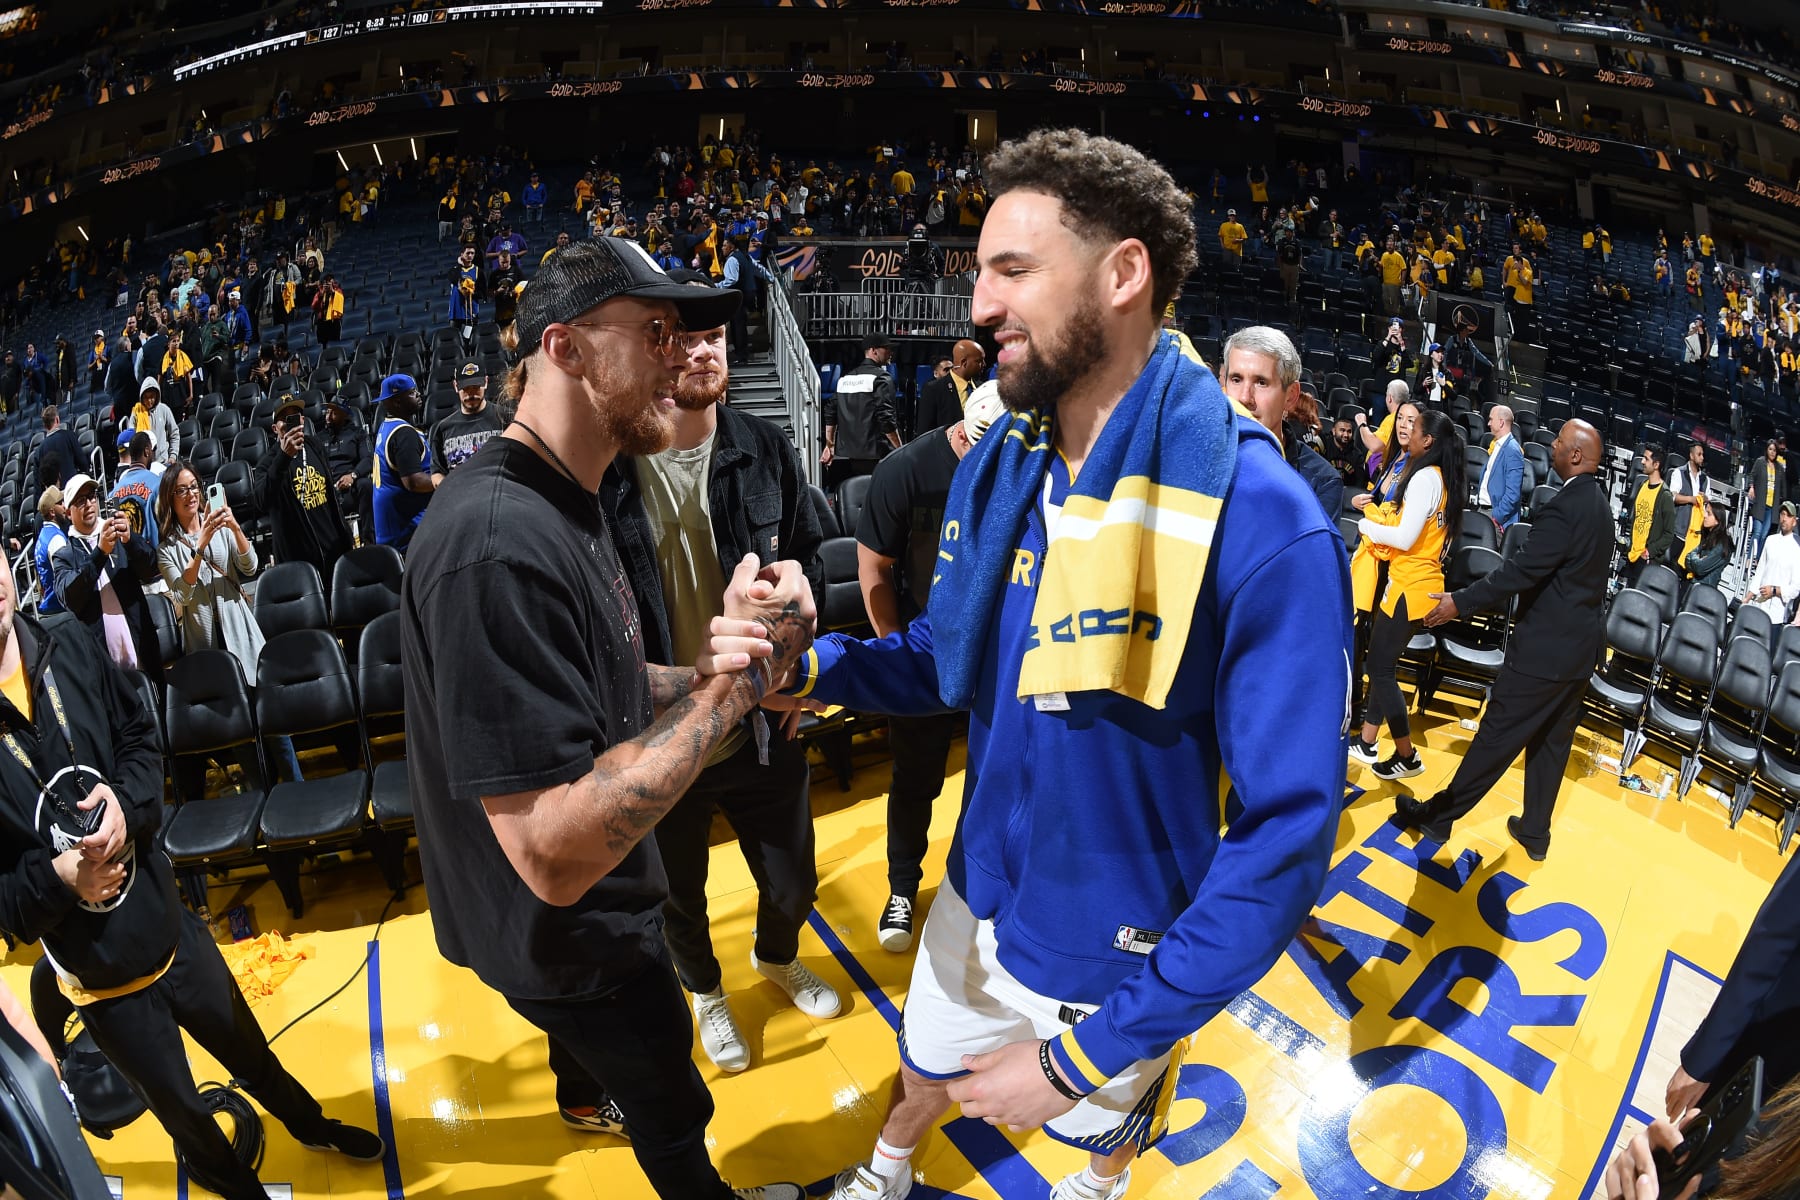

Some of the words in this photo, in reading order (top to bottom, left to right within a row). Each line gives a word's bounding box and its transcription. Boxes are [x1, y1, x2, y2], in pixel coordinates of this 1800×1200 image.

[366, 17, 384, 28] 8:23
[412, 13, 429, 23] 100
[323, 27, 339, 38] 127
[545, 83, 573, 96] GOLD
[575, 80, 622, 98] BLOODED
[796, 73, 824, 87] GOLD
[826, 74, 874, 89] BLOODED
[1049, 78, 1077, 92] GOLD
[1079, 80, 1126, 95] BLOODED
[304, 110, 330, 126] GOLD
[332, 101, 376, 123] BLOODED
[1296, 96, 1324, 113] GOLD
[1325, 101, 1371, 117] BLOODED
[1531, 129, 1557, 147] GOLD
[1559, 136, 1600, 154] BLOODED
